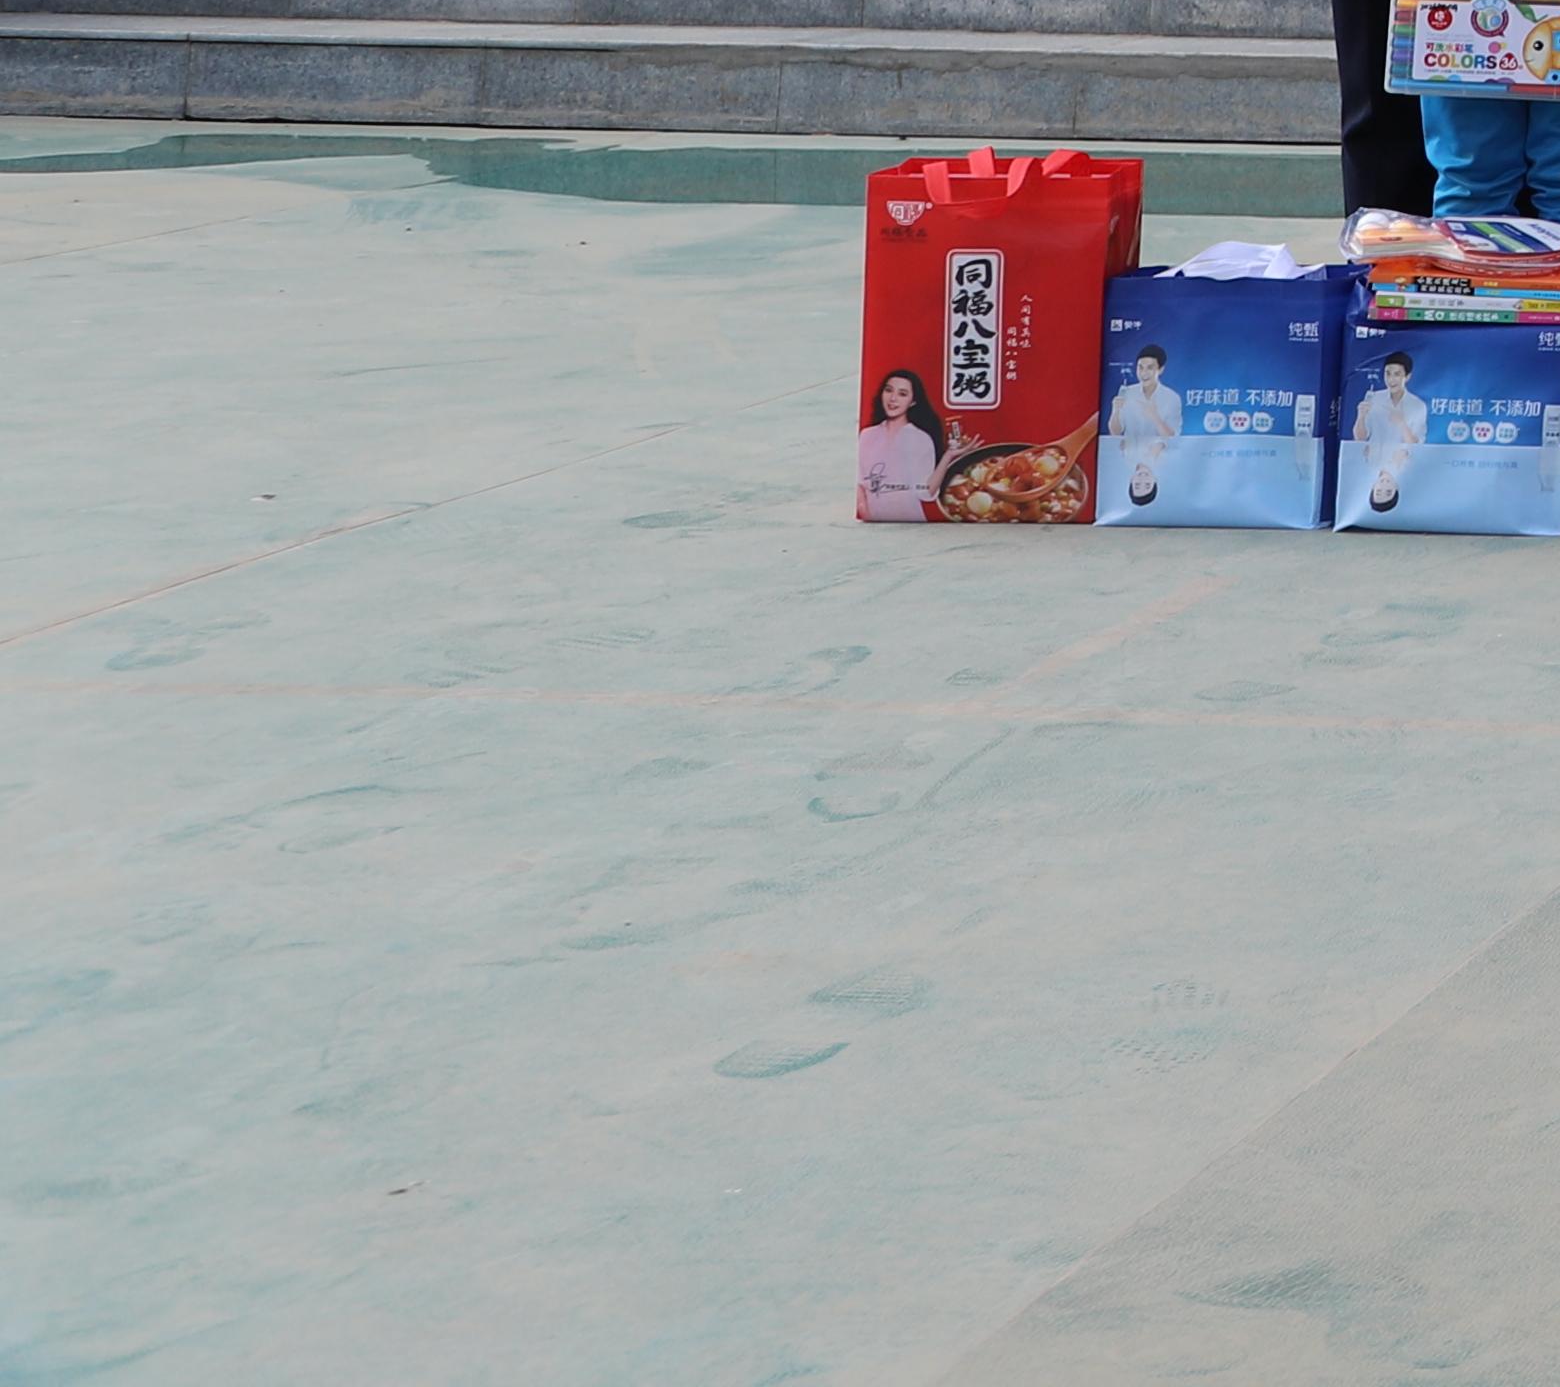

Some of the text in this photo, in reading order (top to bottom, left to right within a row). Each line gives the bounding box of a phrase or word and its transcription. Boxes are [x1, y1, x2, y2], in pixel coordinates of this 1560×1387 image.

[1424, 53, 1517, 70] COLORS 36
[952, 259, 997, 400] 同福八宝粥
[1186, 388, 1293, 406] 好味道 不添加
[1431, 397, 1541, 417] 好味道 不添加
